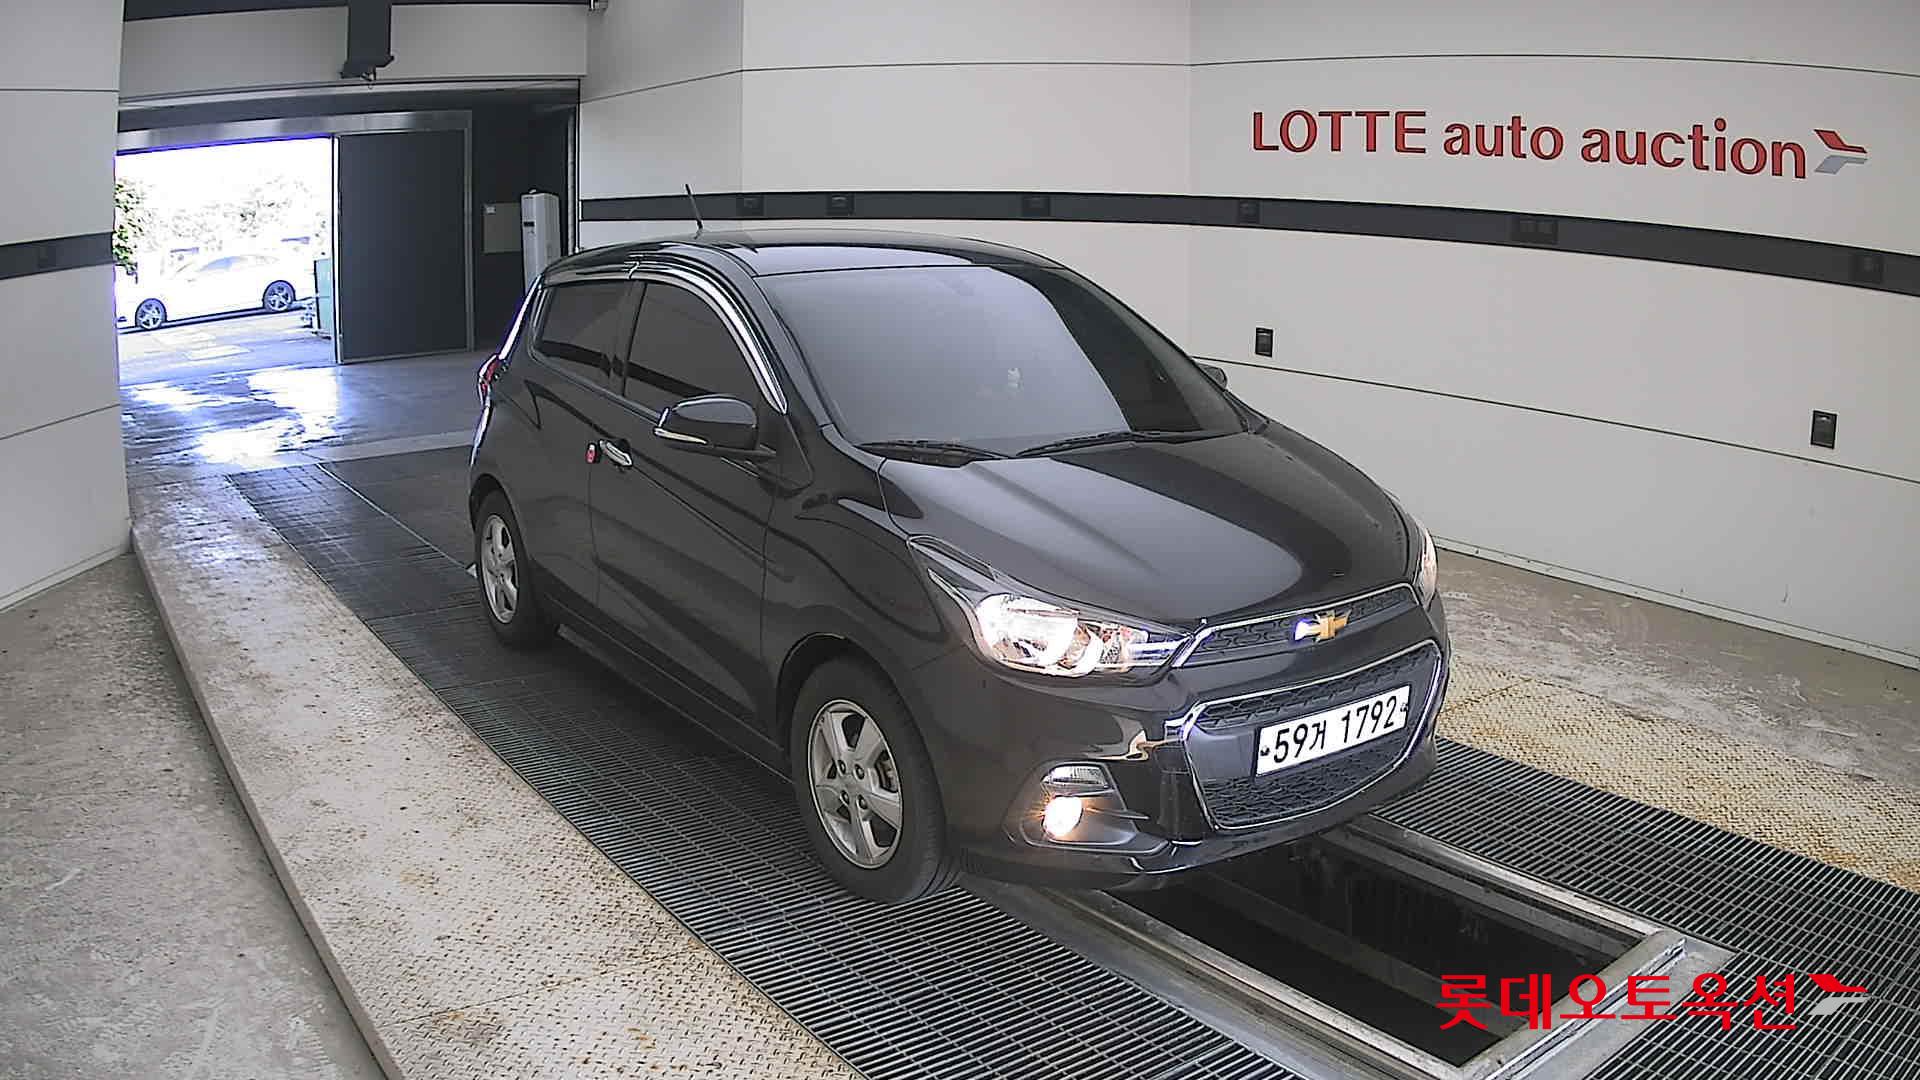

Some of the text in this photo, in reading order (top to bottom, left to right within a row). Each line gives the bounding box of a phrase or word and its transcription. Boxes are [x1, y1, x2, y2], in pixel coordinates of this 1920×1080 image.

[1253, 109, 1807, 179] LOTTE auto auction
[1273, 695, 1397, 763] 59거 1792
